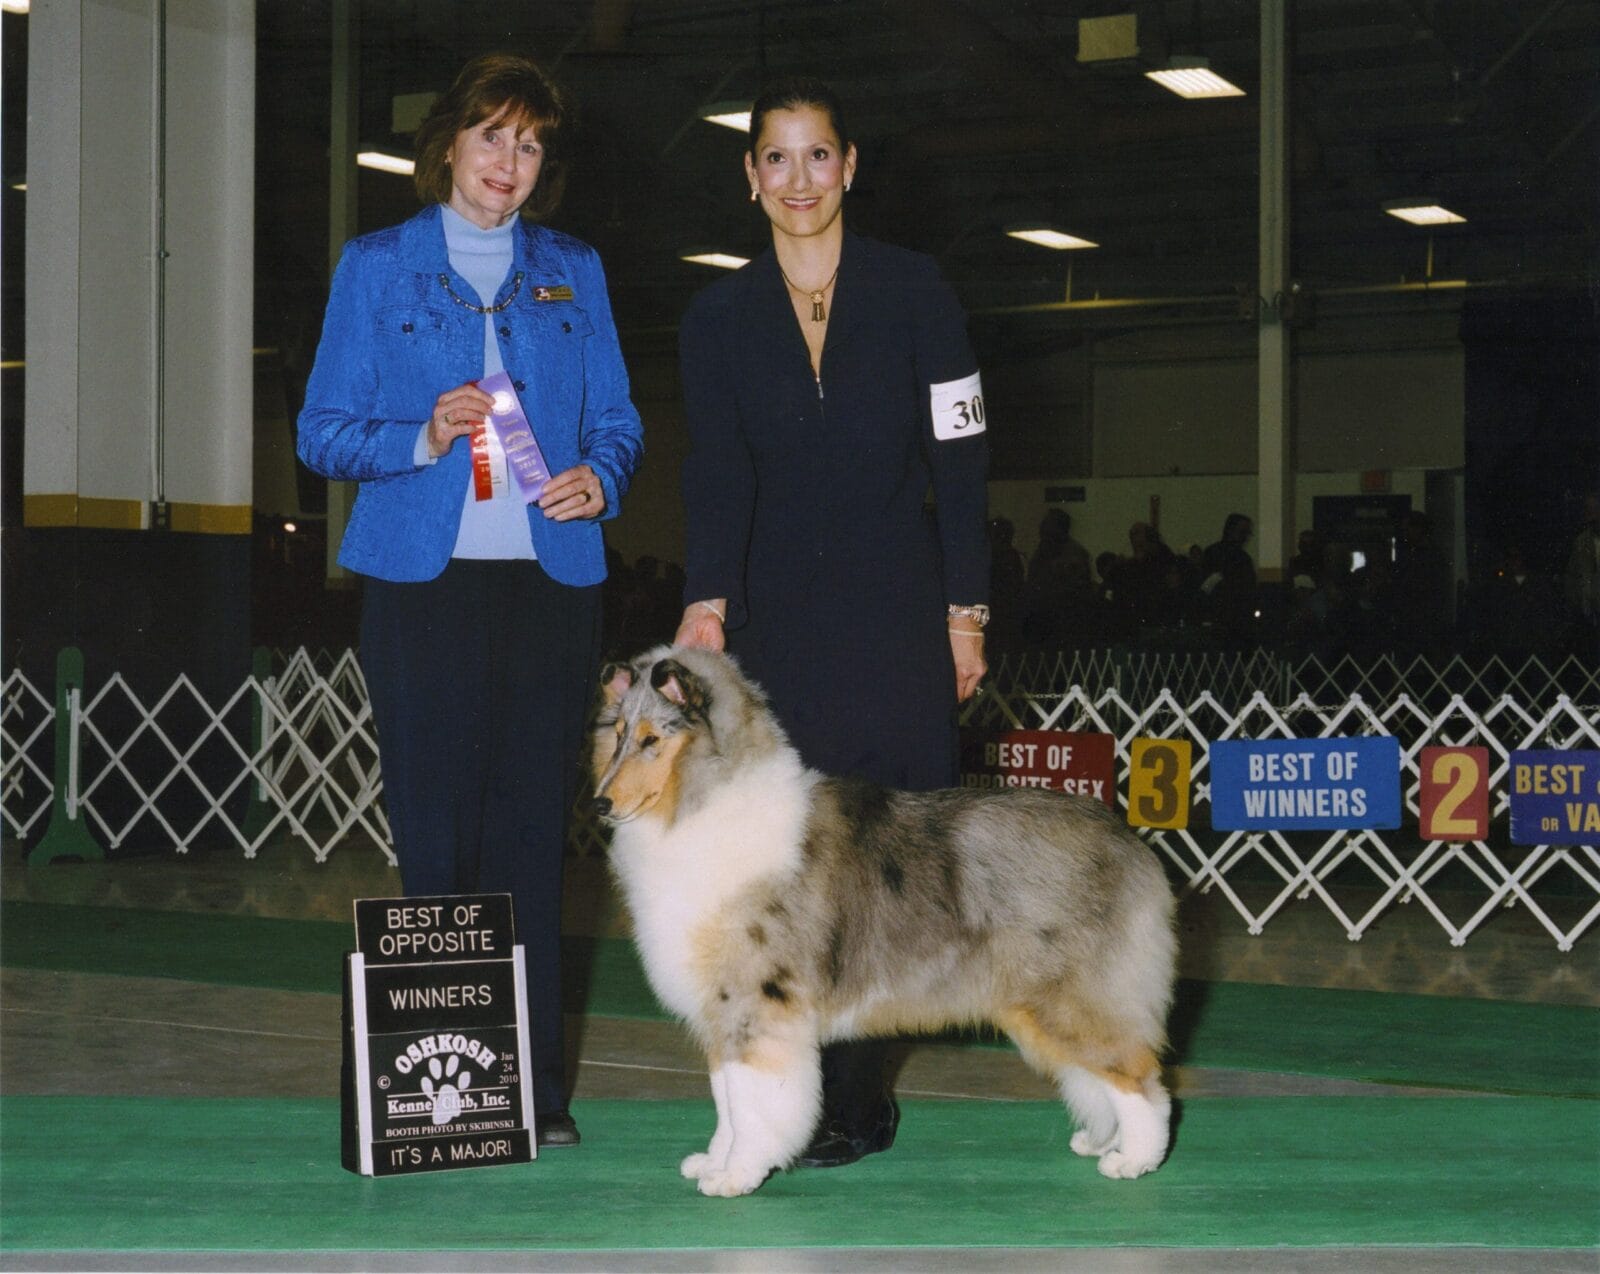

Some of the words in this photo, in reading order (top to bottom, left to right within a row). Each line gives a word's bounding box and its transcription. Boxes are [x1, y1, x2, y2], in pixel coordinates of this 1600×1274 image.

[953, 395, 984, 430] 30
[984, 742, 1039, 769] BEST
[1046, 744, 1073, 771] OF
[1248, 752, 1315, 782] BEST
[1327, 751, 1359, 781] OF
[1138, 745, 1179, 824] 3
[1515, 764, 1586, 795] BEST
[1243, 788, 1368, 818] WINNERS
[1430, 752, 1479, 836] 2
[1541, 817, 1559, 832] OR
[386, 906, 444, 929] BEST
[453, 904, 482, 926] OF
[379, 930, 495, 956] OPPOSITE
[388, 984, 493, 1011] WINNERS
[394, 1033, 497, 1074] OSHKOSH
[500, 1051, 514, 1061] Jan
[499, 1074, 519, 1084] 2010
[503, 1063, 513, 1073] 24
[481, 1092, 511, 1107] Inc.
[385, 1126, 420, 1138] BOOTH
[421, 1124, 454, 1135] PHOTO
[455, 1122, 468, 1132] BY
[469, 1119, 515, 1131] SKIBINSKI
[391, 1145, 422, 1167] IT'S
[431, 1146, 443, 1163] A
[450, 1140, 513, 1161] MAJOR!
